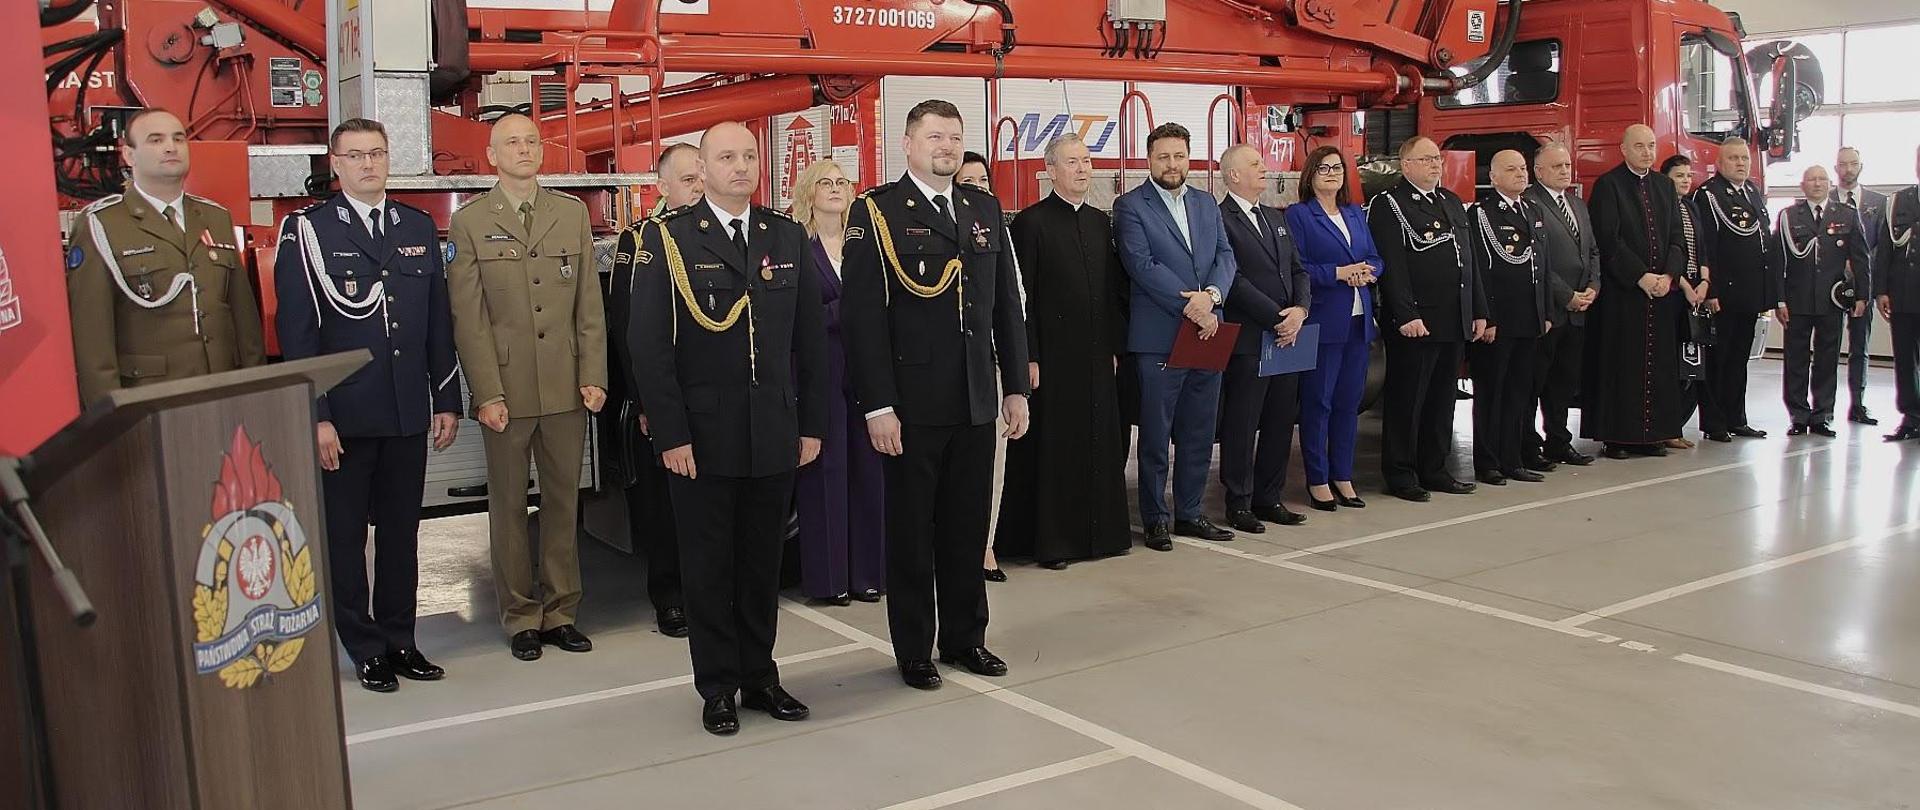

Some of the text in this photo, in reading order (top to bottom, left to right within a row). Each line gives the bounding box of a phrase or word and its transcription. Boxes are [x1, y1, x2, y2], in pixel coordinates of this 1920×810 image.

[833, 6, 935, 29] 3727001069
[1270, 138, 1293, 163] 471
[198, 604, 320, 668] PAŃSTWOWA STRAŻ POŻARNA
